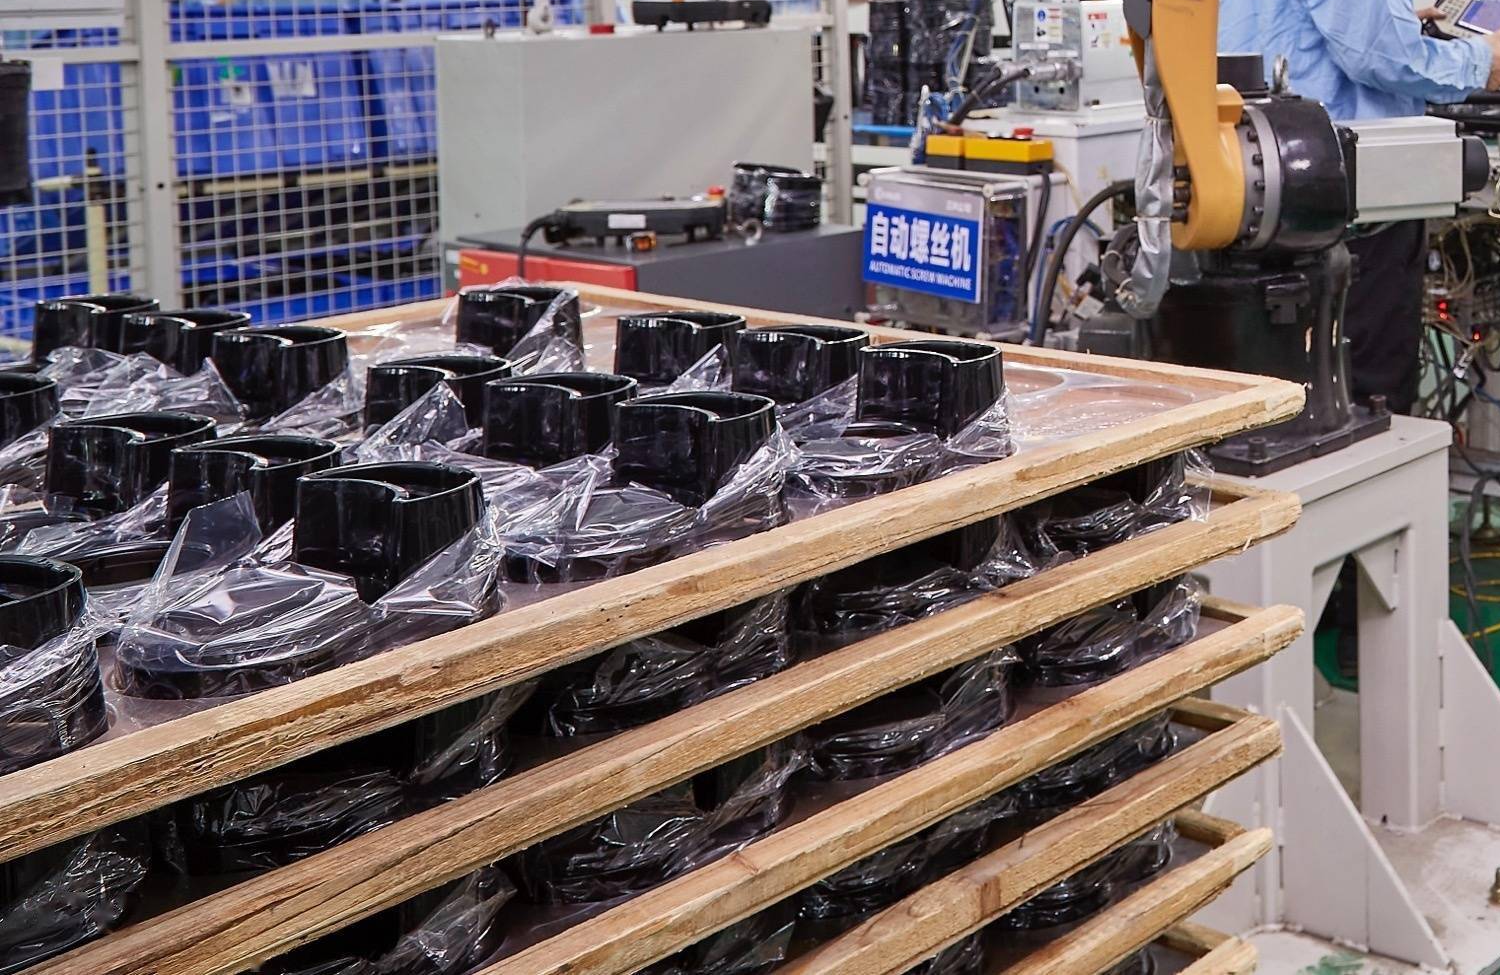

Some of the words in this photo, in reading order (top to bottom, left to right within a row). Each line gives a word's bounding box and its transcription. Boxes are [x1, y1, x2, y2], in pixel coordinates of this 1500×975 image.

[870, 211, 972, 272] 自动螺丝机
